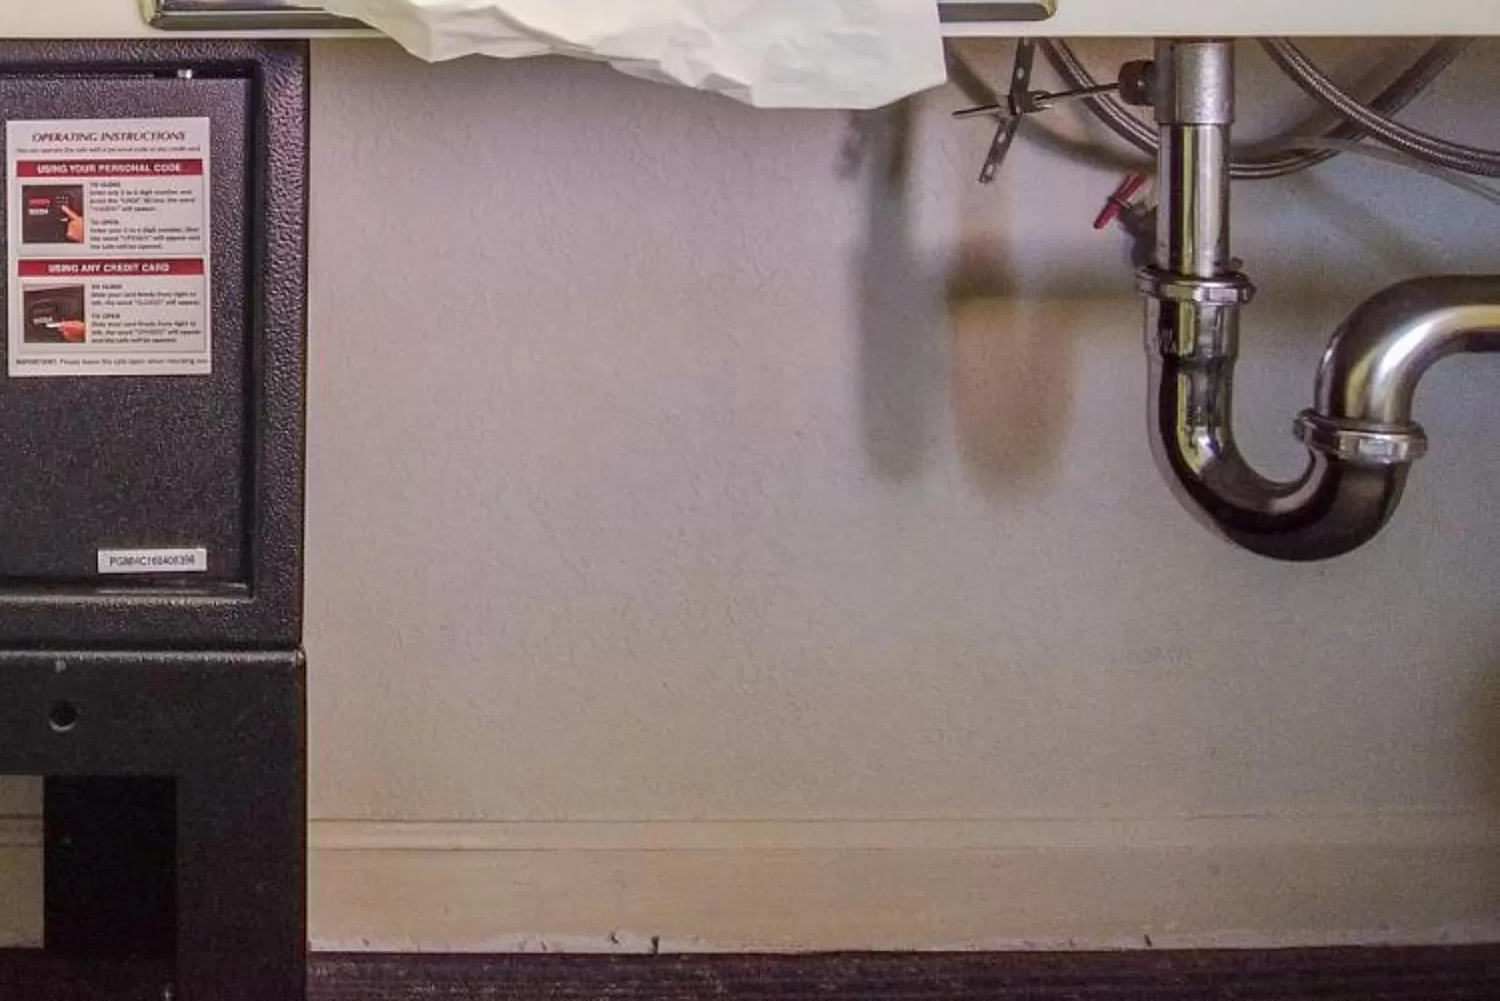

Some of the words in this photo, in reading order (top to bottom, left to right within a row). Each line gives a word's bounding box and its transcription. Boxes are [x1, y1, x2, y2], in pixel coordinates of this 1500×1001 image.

[32, 132, 97, 142] OPERATING
[100, 130, 185, 141] INSTRUCTIONS
[37, 164, 68, 174] USING
[69, 164, 96, 173] YOUR
[98, 163, 149, 173] PERSONAL
[153, 162, 181, 172] CODE
[48, 263, 79, 273] USING
[81, 263, 101, 272] ANY
[103, 263, 140, 272] CREDIT
[142, 262, 170, 272] CARD
